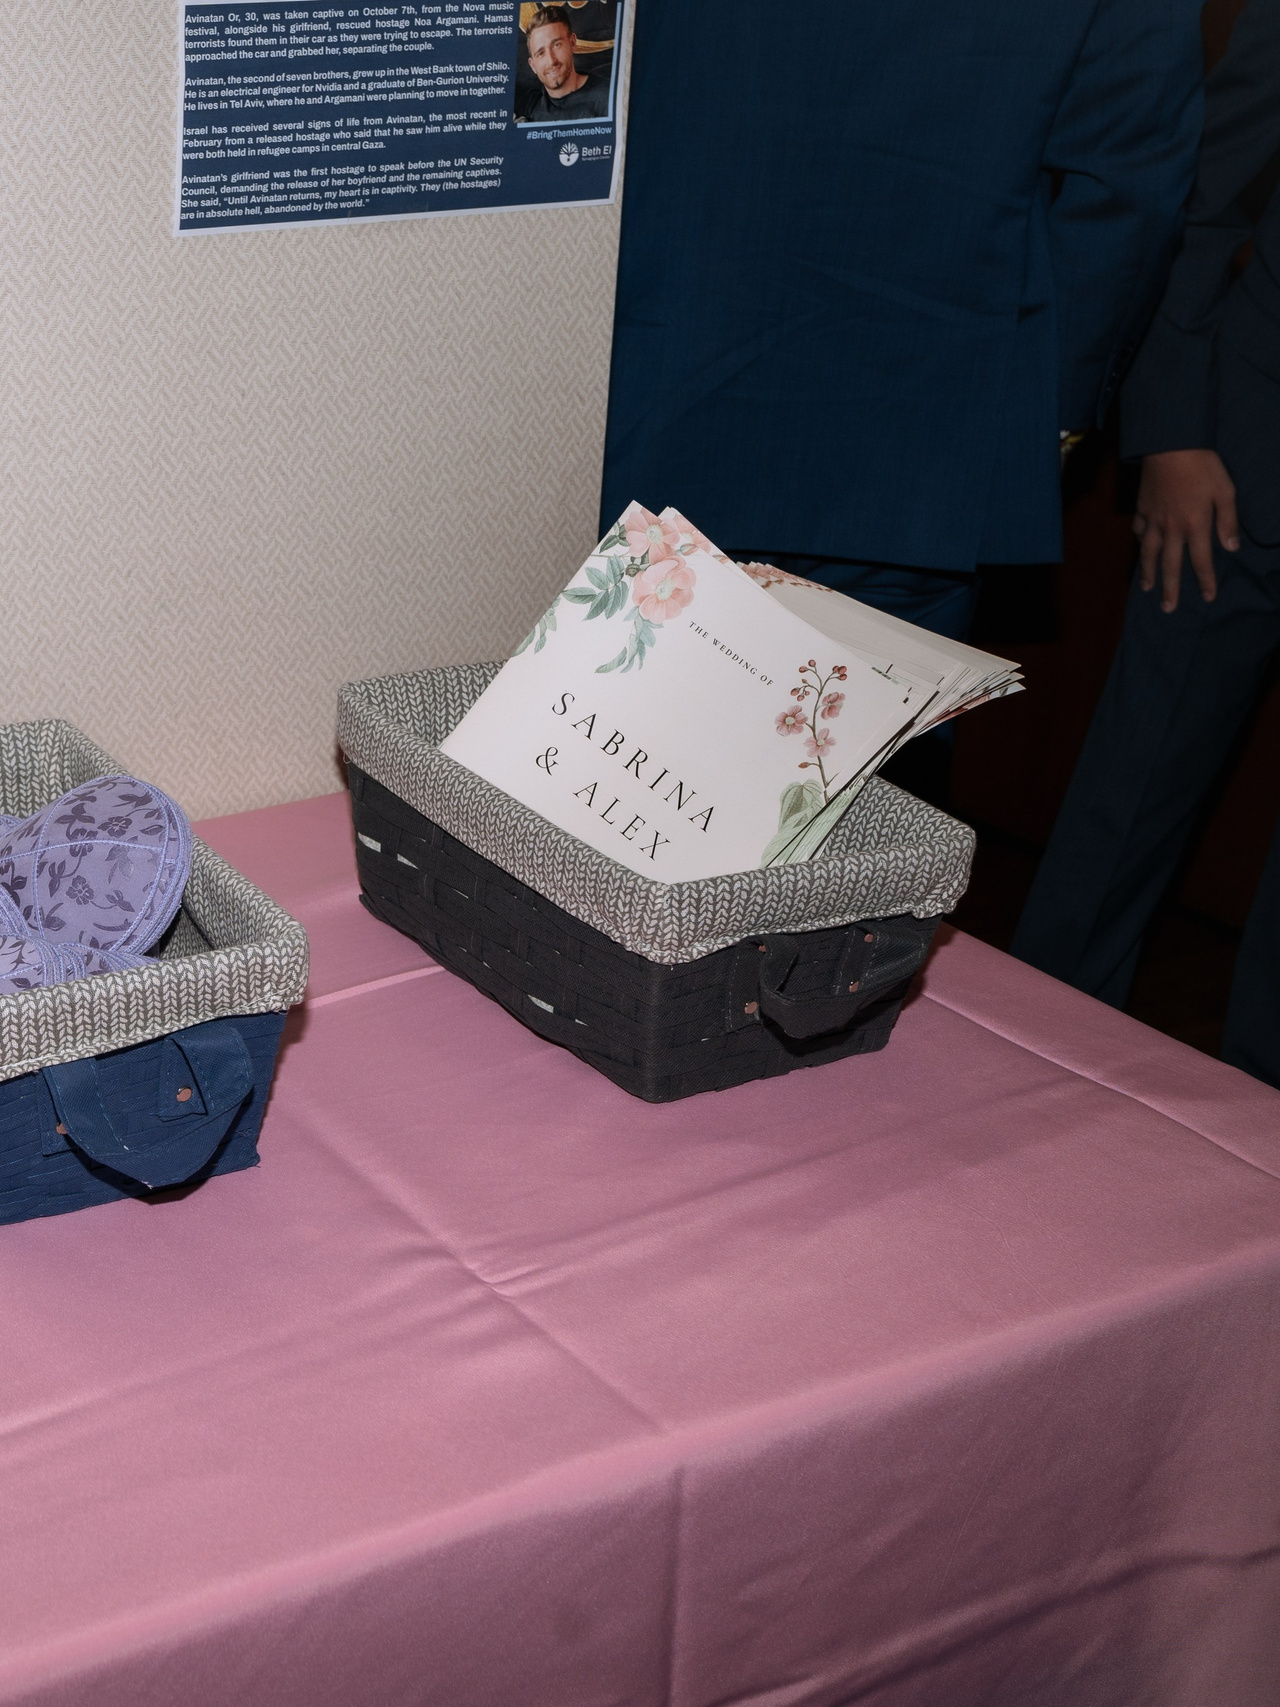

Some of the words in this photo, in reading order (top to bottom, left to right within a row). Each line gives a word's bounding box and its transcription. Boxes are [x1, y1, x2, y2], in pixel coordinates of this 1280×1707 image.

[184, 13, 224, 24] Avinatan
[227, 12, 241, 23] Or,
[244, 11, 259, 22] 30,
[262, 12, 281, 20] was
[284, 10, 309, 19] taken
[312, 8, 344, 20] captive
[347, 9, 359, 17] on
[362, 6, 398, 16] October
[401, 5, 417, 15] 7th,
[421, 4, 441, 13] from
[445, 3, 459, 12] the
[462, 3, 485, 11] Nova
[488, 1, 514, 10] music
[185, 25, 220, 36] festival,
[224, 24, 268, 36] alongside
[272, 23, 286, 32] his
[289, 21, 331, 34] girlfriend,
[336, 19, 371, 30] rescued
[375, 18, 410, 29] hostage
[414, 17, 432, 26] Noa
[435, 14, 479, 27] Argamani.
[484, 14, 513, 23] Hamas
[185, 38, 226, 49] terrorists
[227, 36, 253, 47] found
[254, 36, 277, 46] them
[279, 35, 288, 44] in
[289, 34, 310, 44] their
[311, 35, 326, 43] car
[327, 35, 338, 43] as
[339, 32, 359, 43] they
[360, 33, 382, 41] were
[383, 30, 408, 41] trying
[409, 30, 419, 39] to
[420, 29, 453, 39] escape.
[455, 27, 472, 36] The
[473, 26, 513, 35] terrorists
[185, 50, 237, 63] approached
[238, 49, 253, 59] the
[254, 50, 269, 58] car
[269, 47, 287, 57] and
[287, 46, 324, 59] grabbed
[325, 45, 341, 55] her,
[342, 43, 388, 55] separating
[388, 43, 403, 52] the
[403, 41, 434, 52] couple.
[184, 90, 197, 99] He
[198, 89, 206, 98] is
[220, 86, 261, 97] electrical
[261, 85, 301, 96] engineer
[301, 83, 314, 92] for
[315, 82, 342, 92] Nvidia
[343, 81, 360, 91] and
[360, 82, 366, 90] a
[367, 79, 405, 91] graduate
[406, 78, 415, 87] of
[416, 75, 464, 87] Ben-Gurion
[465, 73, 509, 84] University.
[182, 138, 222, 148] February
[224, 136, 245, 145] from
[255, 133, 293, 144] released
[295, 132, 331, 142] hostage
[332, 130, 351, 139] who
[353, 128, 371, 138] said
[373, 128, 391, 137] that
[392, 127, 404, 135] he
[405, 127, 423, 135] saw
[425, 124, 441, 133] him
[442, 123, 463, 132] alive
[464, 121, 487, 131] while
[488, 121, 507, 130] they
[183, 125, 208, 136] Israel
[211, 125, 228, 134] has
[231, 122, 269, 133] received
[272, 120, 304, 131] several
[307, 119, 331, 130] signs
[334, 118, 343, 127] of
[346, 117, 360, 126] life
[363, 116, 383, 125] from
[386, 115, 425, 124] Avinatan,
[428, 112, 443, 122] the
[445, 111, 467, 120] most
[469, 109, 496, 119] recent
[499, 109, 507, 117] in
[526, 126, 612, 141] #BringThemHomeNow
[182, 152, 204, 160] were
[205, 149, 226, 159] both
[227, 147, 246, 157] held
[247, 147, 256, 156] in
[257, 146, 290, 157] refugee
[291, 145, 320, 154] camps
[321, 143, 330, 151] in
[330, 141, 361, 151] central
[361, 140, 386, 149] Gaza.
[581, 146, 601, 157] Beth
[603, 145, 612, 155] El
[181, 173, 228, 184] Avinatan’s
[230, 170, 270, 183] girlfriend
[272, 170, 291, 178] was
[293, 168, 308, 177] the
[310, 167, 328, 176] first
[330, 165, 365, 175] hostage
[367, 164, 377, 172] to
[379, 161, 405, 173] speak
[407, 160, 435, 169] before
[437, 159, 451, 168] the
[453, 157, 467, 166] UN
[469, 156, 504, 165] Security
[181, 185, 218, 196] Council,
[220, 182, 269, 194] demanding
[270, 181, 285, 190] the
[286, 180, 318, 189] release
[320, 178, 330, 187] of
[331, 177, 346, 186] her
[347, 174, 387, 186] boyfriend
[388, 173, 405, 182] and
[406, 172, 420, 181] the
[422, 169, 464, 180] remaining
[465, 167, 502, 178] captives.
[181, 198, 199, 208] She
[200, 197, 221, 207] said,
[223, 195, 248, 205] “Until
[249, 193, 288, 203] Avinatan
[289, 192, 322, 200] returns,
[324, 191, 337, 199] my
[338, 188, 361, 197] heart
[362, 187, 370, 195] is
[371, 186, 379, 194] in
[381, 184, 418, 195] captivity.
[420, 182, 441, 192] They
[442, 181, 459, 191] (the
[460, 178, 501, 189] hostages)
[689, 620, 709, 639] THE
[712, 638, 758, 675] WEDDING
[760, 674, 774, 686] OF
[551, 692, 714, 833] SABRINA
[535, 746, 559, 776] &
[572, 781, 671, 861] ALEX
